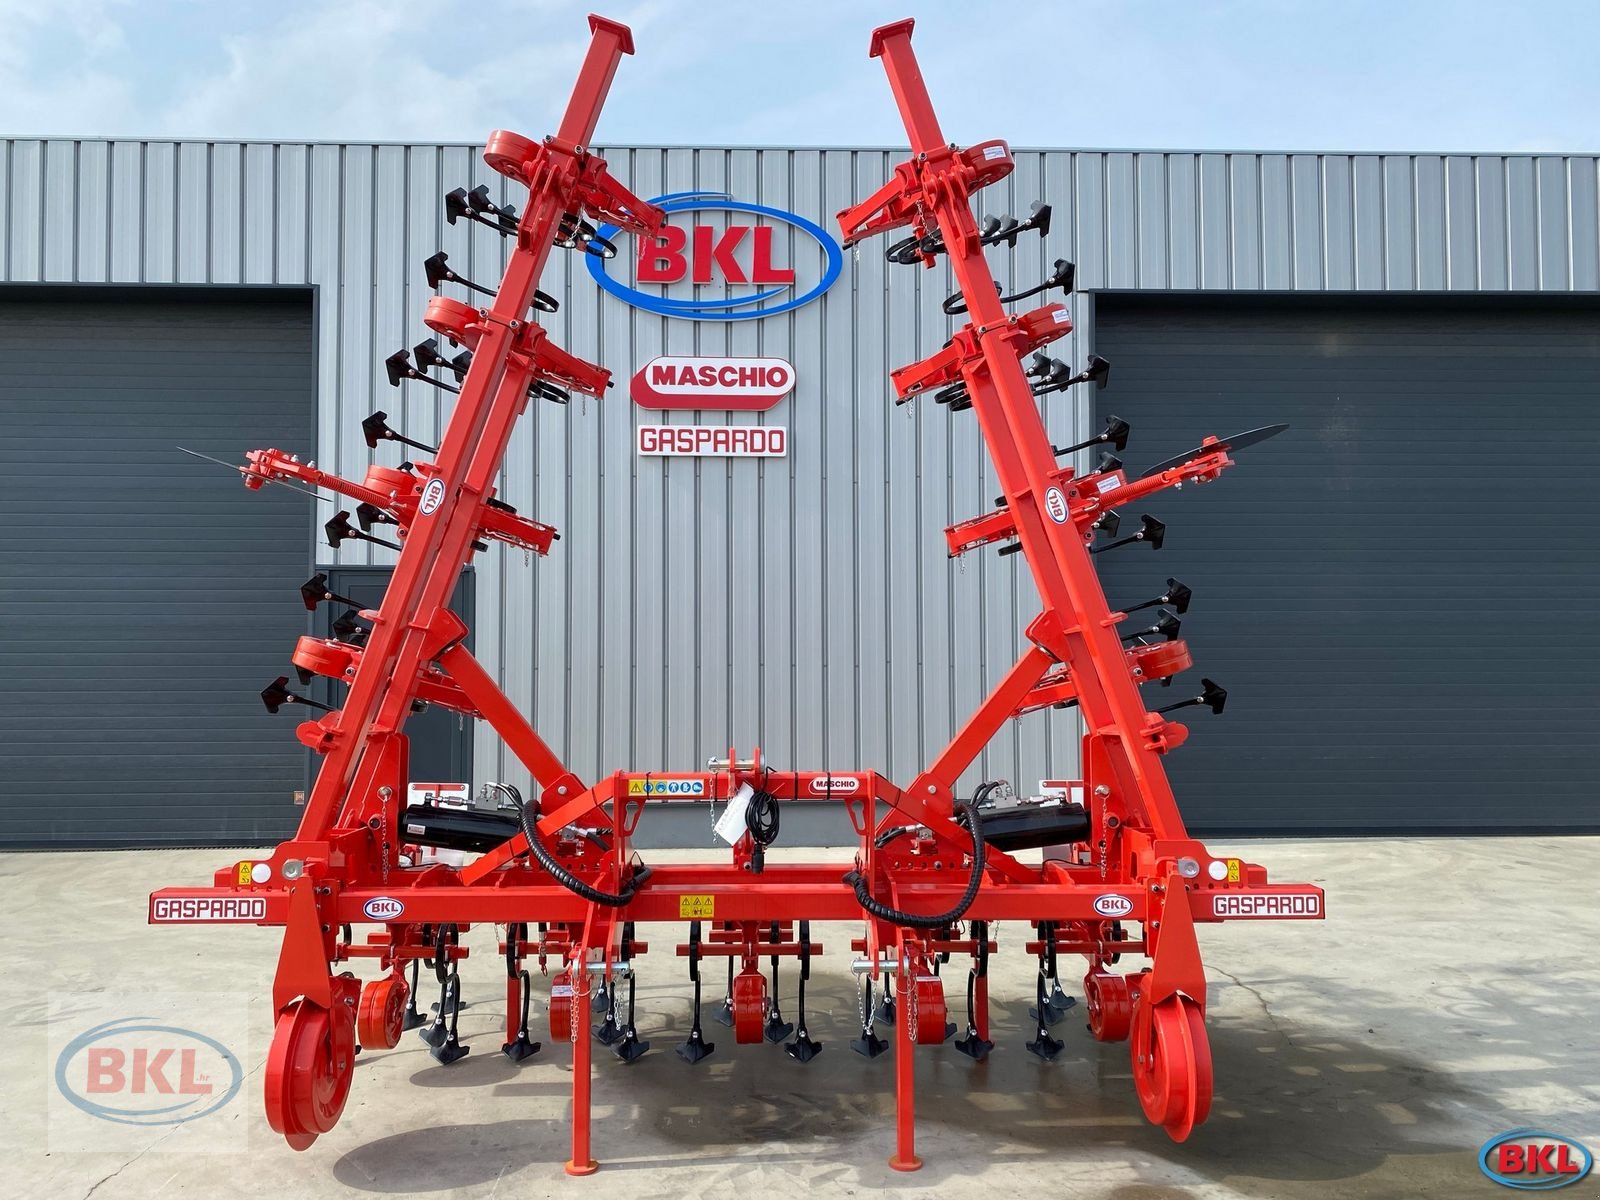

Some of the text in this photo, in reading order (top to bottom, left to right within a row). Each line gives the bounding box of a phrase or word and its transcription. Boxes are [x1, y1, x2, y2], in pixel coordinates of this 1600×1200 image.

[636, 224, 795, 285] BKL
[652, 365, 788, 388] MASCHIO
[640, 428, 785, 454] GASPARDO
[425, 485, 442, 511] BKL
[1048, 493, 1064, 517] BKL
[816, 780, 856, 788] MASCHIO
[155, 899, 265, 919] GASPARDO
[371, 902, 399, 914] BKL
[1101, 899, 1128, 911] BKL
[1215, 896, 1318, 915] GASPARDO
